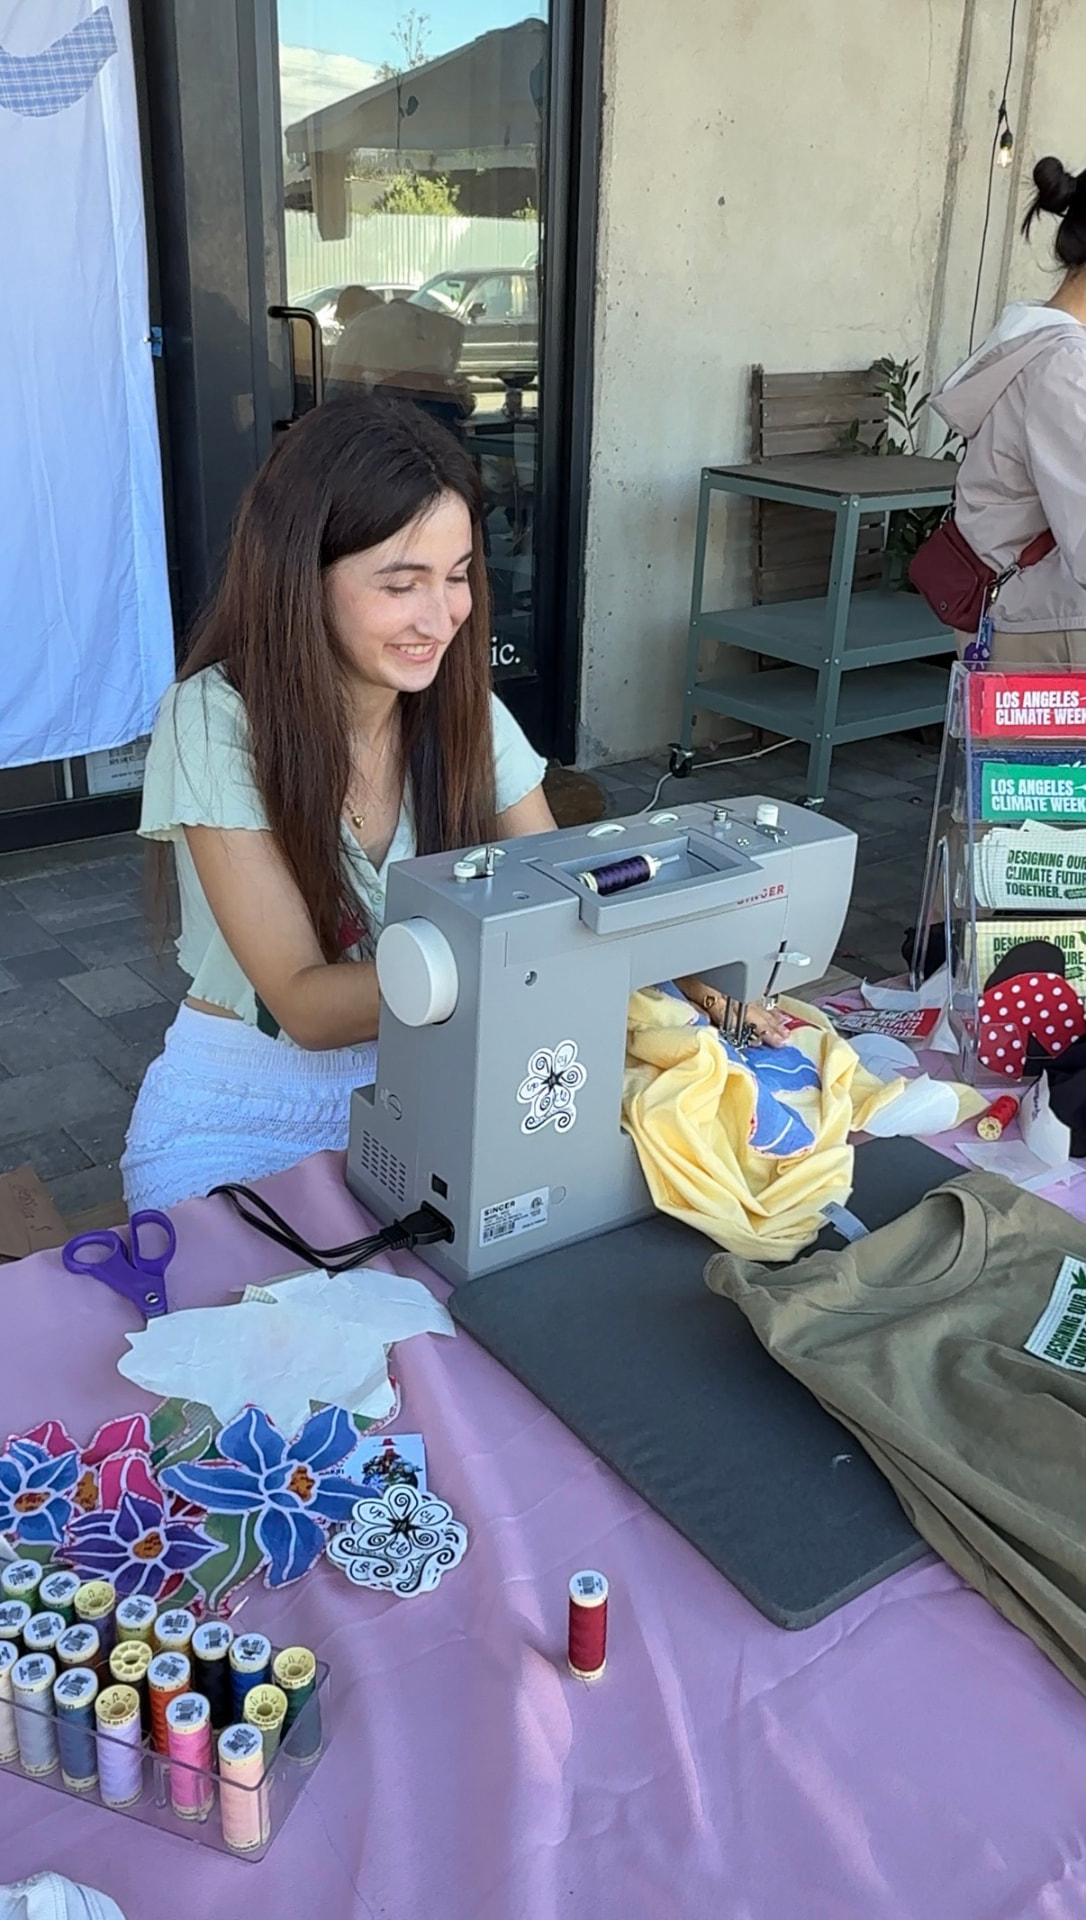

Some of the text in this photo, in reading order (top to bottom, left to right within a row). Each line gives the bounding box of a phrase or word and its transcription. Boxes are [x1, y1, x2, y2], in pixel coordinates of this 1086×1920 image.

[490, 636, 521, 667] ic.
[995, 690, 1080, 709] LOS ANGELES
[995, 708, 1051, 726] CLIMATE
[990, 778, 1075, 797] LOS ANGELES
[991, 796, 1086, 813] CLIMATE WEEK
[1007, 849, 1064, 868] DESIGNING
[1005, 866, 1086, 886] CLIMATE FUTUR
[1005, 881, 1064, 899] TOGETHER.
[1053, 934, 1076, 950] OUR
[484, 1200, 516, 1217] SINGER
[1043, 1315, 1081, 1361] DESIGNING
[368, 1505, 436, 1524] up cy
